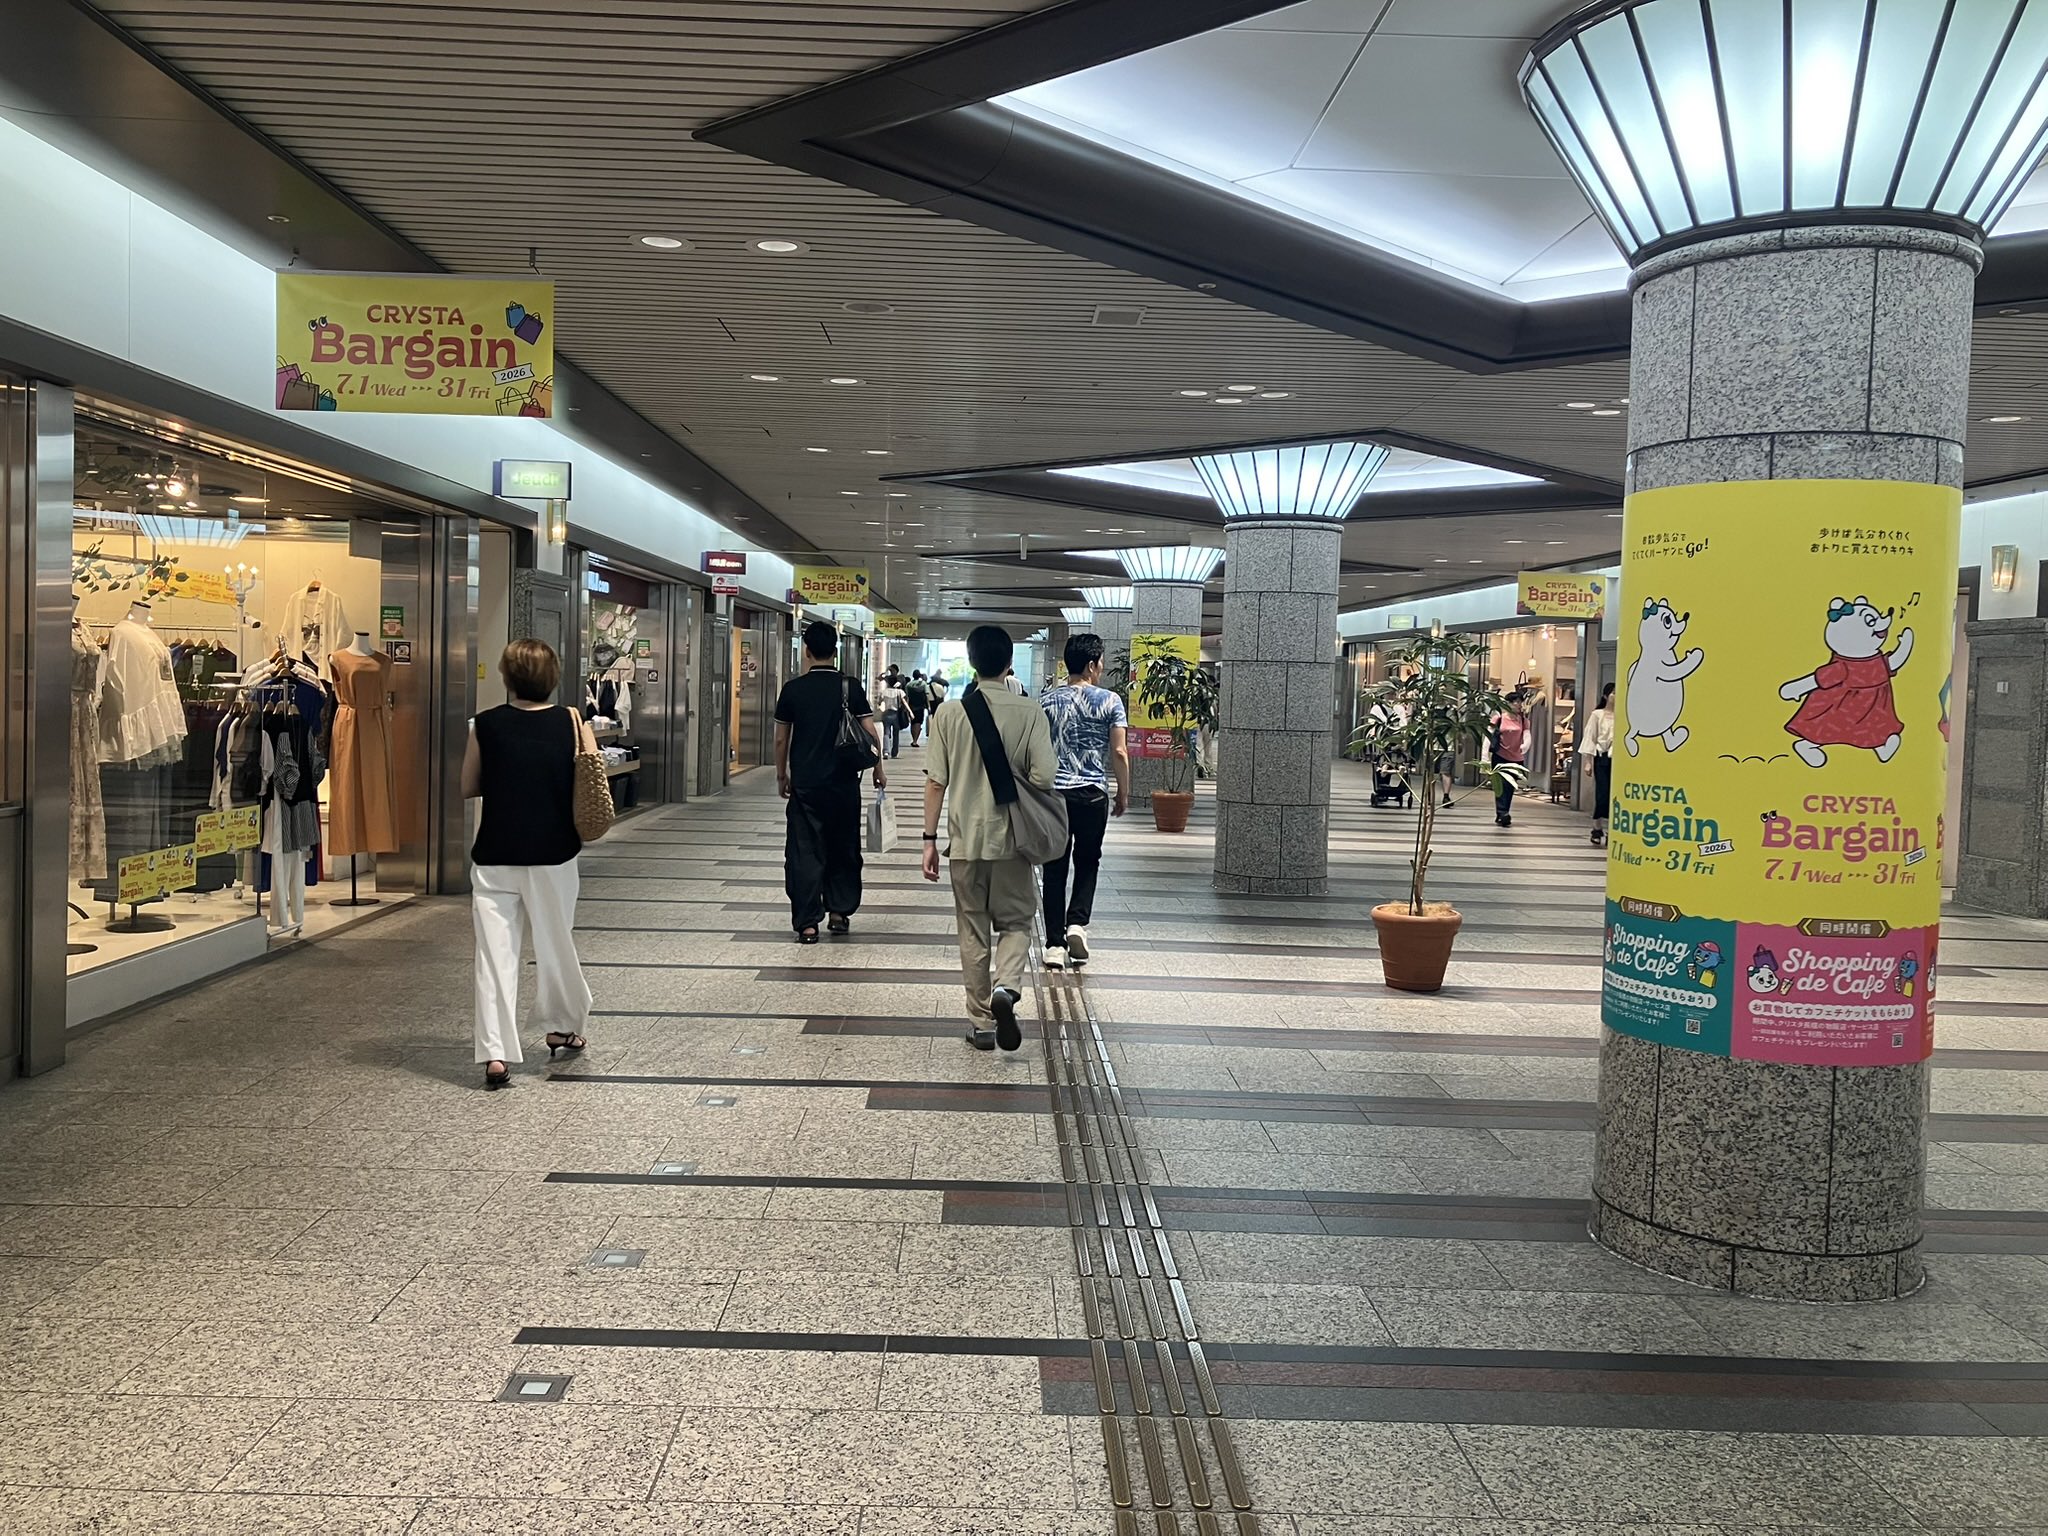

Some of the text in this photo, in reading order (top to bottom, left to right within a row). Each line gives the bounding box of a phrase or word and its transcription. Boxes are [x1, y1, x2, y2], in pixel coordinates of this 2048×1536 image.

[367, 304, 465, 325] CRYSTA
[311, 323, 518, 380] Bargain
[500, 368, 526, 381] 2026
[337, 373, 491, 399] 7.1 Wed 31 Fri
[1818, 527, 1910, 541] 歩けば気分わくわく
[1685, 538, 1709, 558] Go!
[1810, 543, 1914, 555] おトクに買えてウキウキ
[802, 578, 859, 595] Bargain
[1546, 581, 1577, 589] CRYSTA
[1528, 587, 1594, 606] Bargain
[1567, 604, 1578, 612] 31
[879, 620, 913, 630] Bargain
[1624, 782, 1688, 804] CRYSTA
[1803, 795, 1896, 814] CRYSTA
[1612, 800, 1719, 847] Bargain
[1703, 843, 1727, 853] 2026
[1761, 815, 1919, 862] Bargain
[1611, 840, 1715, 875] 7.1 Wed 31 Fri
[1764, 858, 1916, 884] 7.1 Wed 31 Fri
[1627, 901, 1663, 918] 同時開催
[1820, 922, 1871, 934] 同時開催
[1613, 923, 1691, 963] Shopping
[1617, 948, 1632, 965] de
[1782, 948, 1898, 979] Shopping
[1797, 973, 1829, 991] de
